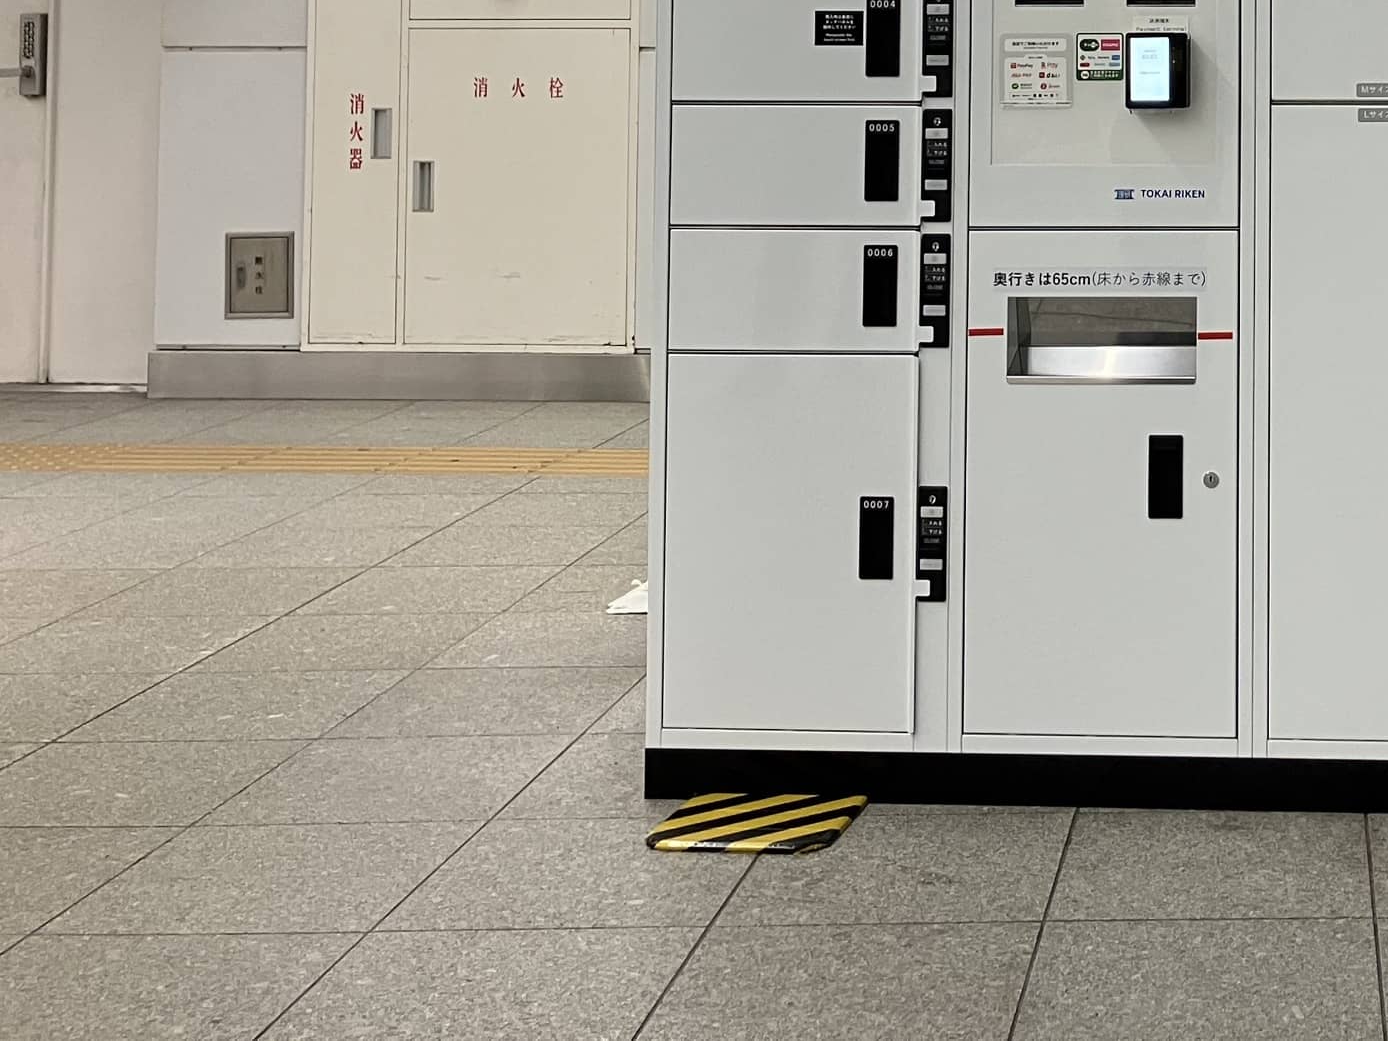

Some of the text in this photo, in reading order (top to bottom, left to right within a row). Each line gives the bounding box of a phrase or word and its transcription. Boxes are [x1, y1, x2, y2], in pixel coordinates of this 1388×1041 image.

[870, 0, 896, 8] 0004
[350, 93, 364, 170] 消火器
[869, 124, 895, 132] 0005
[1140, 189, 1205, 199] TOKAI RIKEN
[867, 248, 893, 257] 0006
[863, 499, 889, 509] 0007
